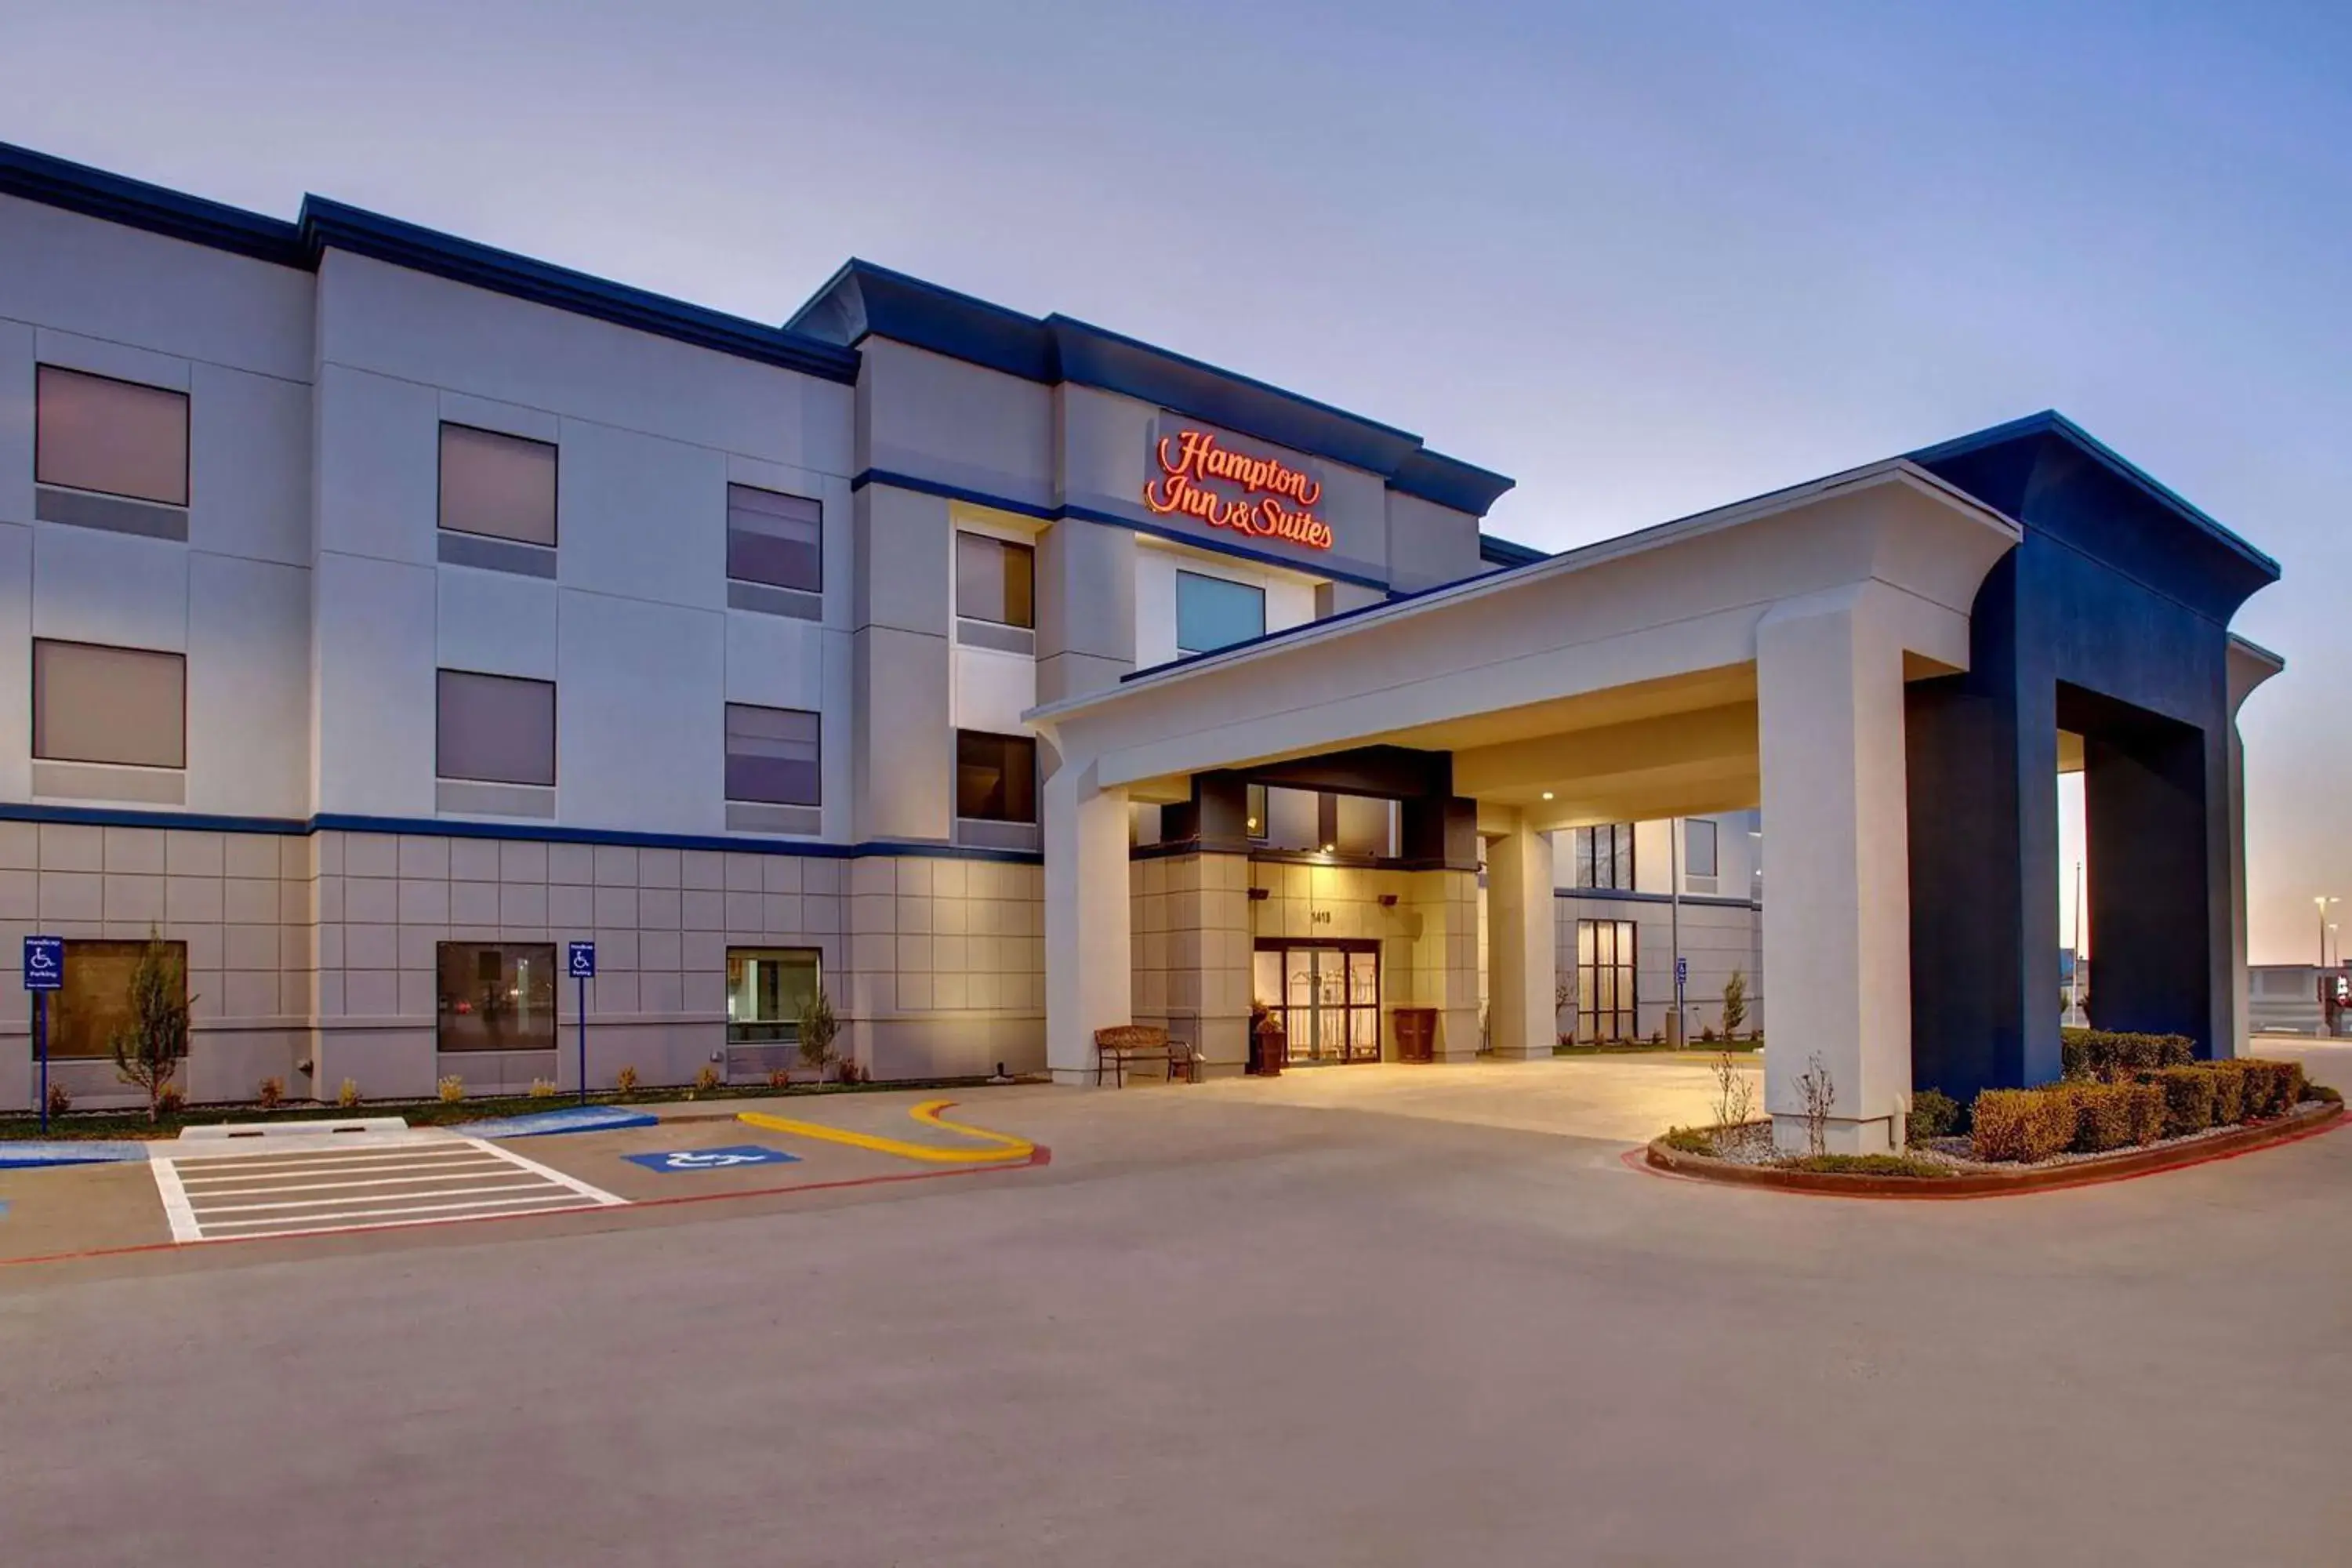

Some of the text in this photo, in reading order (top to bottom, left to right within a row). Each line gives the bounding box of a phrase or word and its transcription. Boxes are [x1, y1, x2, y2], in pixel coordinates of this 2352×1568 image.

[1159, 431, 1320, 505] Hampton
[1146, 474, 1333, 549] Inn & Suites
